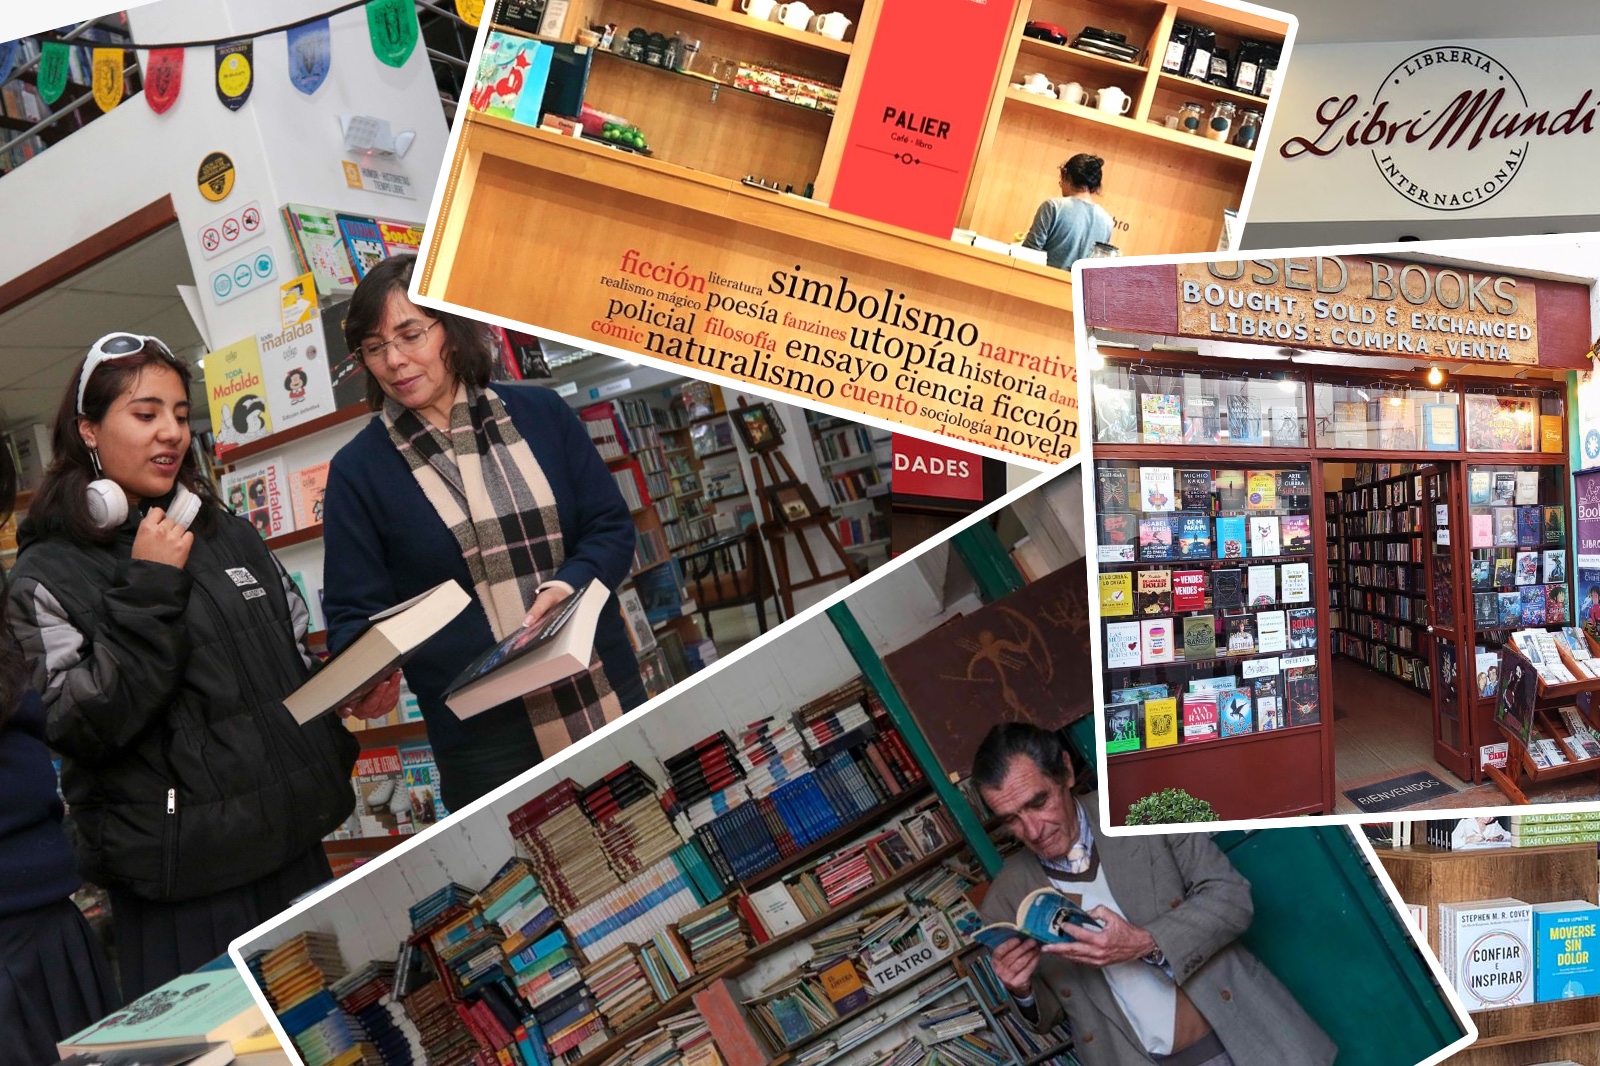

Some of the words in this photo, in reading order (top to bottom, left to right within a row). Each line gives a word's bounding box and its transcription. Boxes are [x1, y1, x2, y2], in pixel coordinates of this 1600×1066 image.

[1404, 50, 1492, 77] LIBRERIA
[882, 106, 951, 140] PALIER
[890, 133, 910, 145] Café
[915, 138, 933, 151] libro
[1381, 147, 1522, 206] INTERNACIONAL
[618, 250, 706, 294] ficción
[708, 271, 763, 296] literatura
[600, 274, 654, 298] realismo
[656, 290, 702, 311] mágico
[1366, 261, 1519, 316] BOOKS
[605, 298, 697, 336] policial
[704, 291, 778, 325] poesía
[768, 265, 979, 347] simbolismo
[1183, 281, 1305, 321] BOUGHT,
[1313, 299, 1376, 325] SOLD
[1386, 306, 1399, 327] &
[1411, 312, 1532, 341] EXCHANGED
[261, 322, 314, 353] mafalda
[590, 318, 645, 344] cómic
[703, 316, 777, 352] filosofía
[781, 311, 847, 342] fanzines
[644, 330, 835, 399] naturalismo
[785, 338, 889, 384] ensayo
[850, 326, 956, 376] utopía
[213, 372, 259, 400] Mafalda
[225, 368, 243, 381] TODA
[959, 355, 1048, 401] historia
[840, 383, 918, 416] cuento
[895, 370, 984, 413] ciencia
[991, 393, 1079, 439] ficción
[919, 406, 992, 436] sociología
[994, 423, 1072, 460] novela
[895, 453, 970, 478] DADES
[267, 465, 283, 531] mafalda
[1174, 586, 1198, 595] VENDES
[1180, 575, 1203, 584] VENDES
[1188, 713, 1213, 722] RAND
[1357, 778, 1440, 806] BIENVENIDOS
[1461, 913, 1491, 923] STEPHEN
[1492, 912, 1500, 920] M.
[1509, 910, 1530, 918] COVEY
[1550, 924, 1596, 940] MOVERSE
[1473, 946, 1520, 962] CONFIAR
[1557, 951, 1589, 967] DOLOR
[1564, 939, 1582, 952] SIN
[874, 948, 932, 985] TEATRO
[1471, 970, 1523, 988] INSPIRAR
